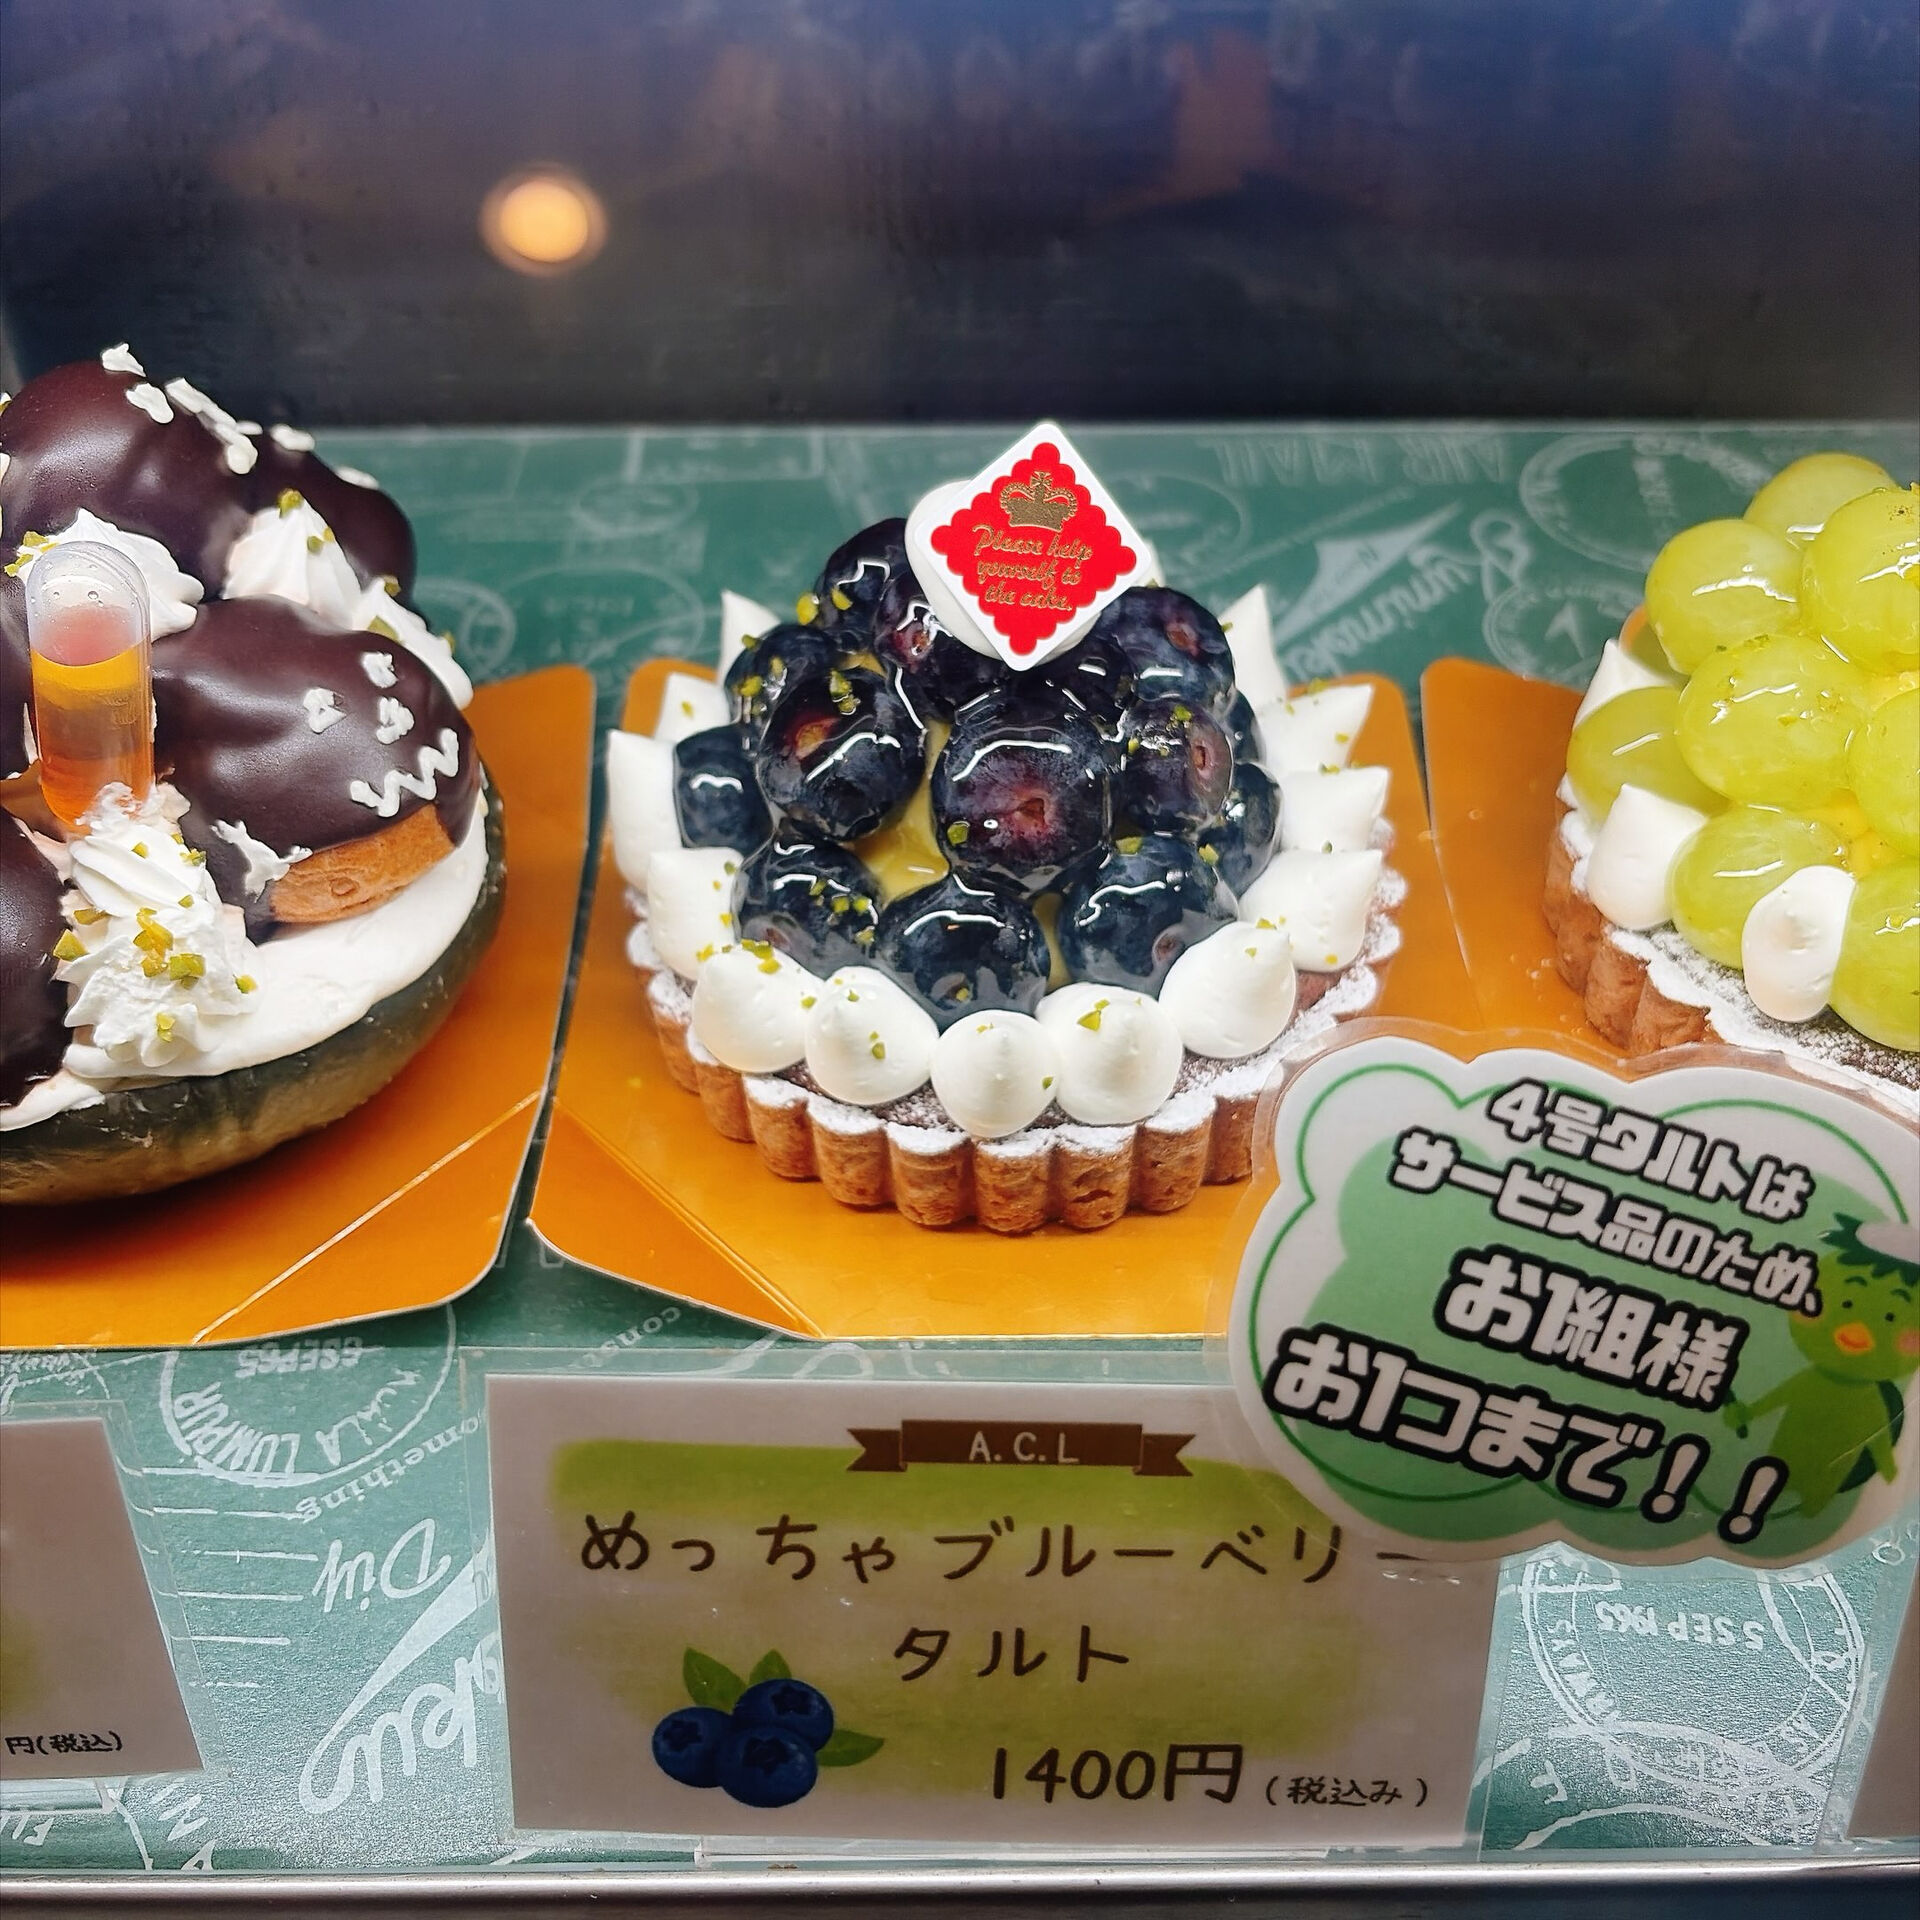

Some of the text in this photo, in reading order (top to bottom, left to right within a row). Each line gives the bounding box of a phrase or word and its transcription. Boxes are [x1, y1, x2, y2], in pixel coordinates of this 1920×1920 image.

[972, 524, 1093, 569] Please help
[976, 557, 1082, 590] yourself to
[985, 580, 1016, 605] the
[1487, 1077, 1816, 1223] 4号タルトは
[1389, 1127, 1823, 1317] サービス品のため、
[1434, 1245, 1750, 1412] お1組様
[295, 1409, 485, 1523] omething
[968, 1431, 1079, 1464] A.C.L
[895, 1626, 1130, 1682] タルト
[993, 1743, 1244, 1803] 1400円
